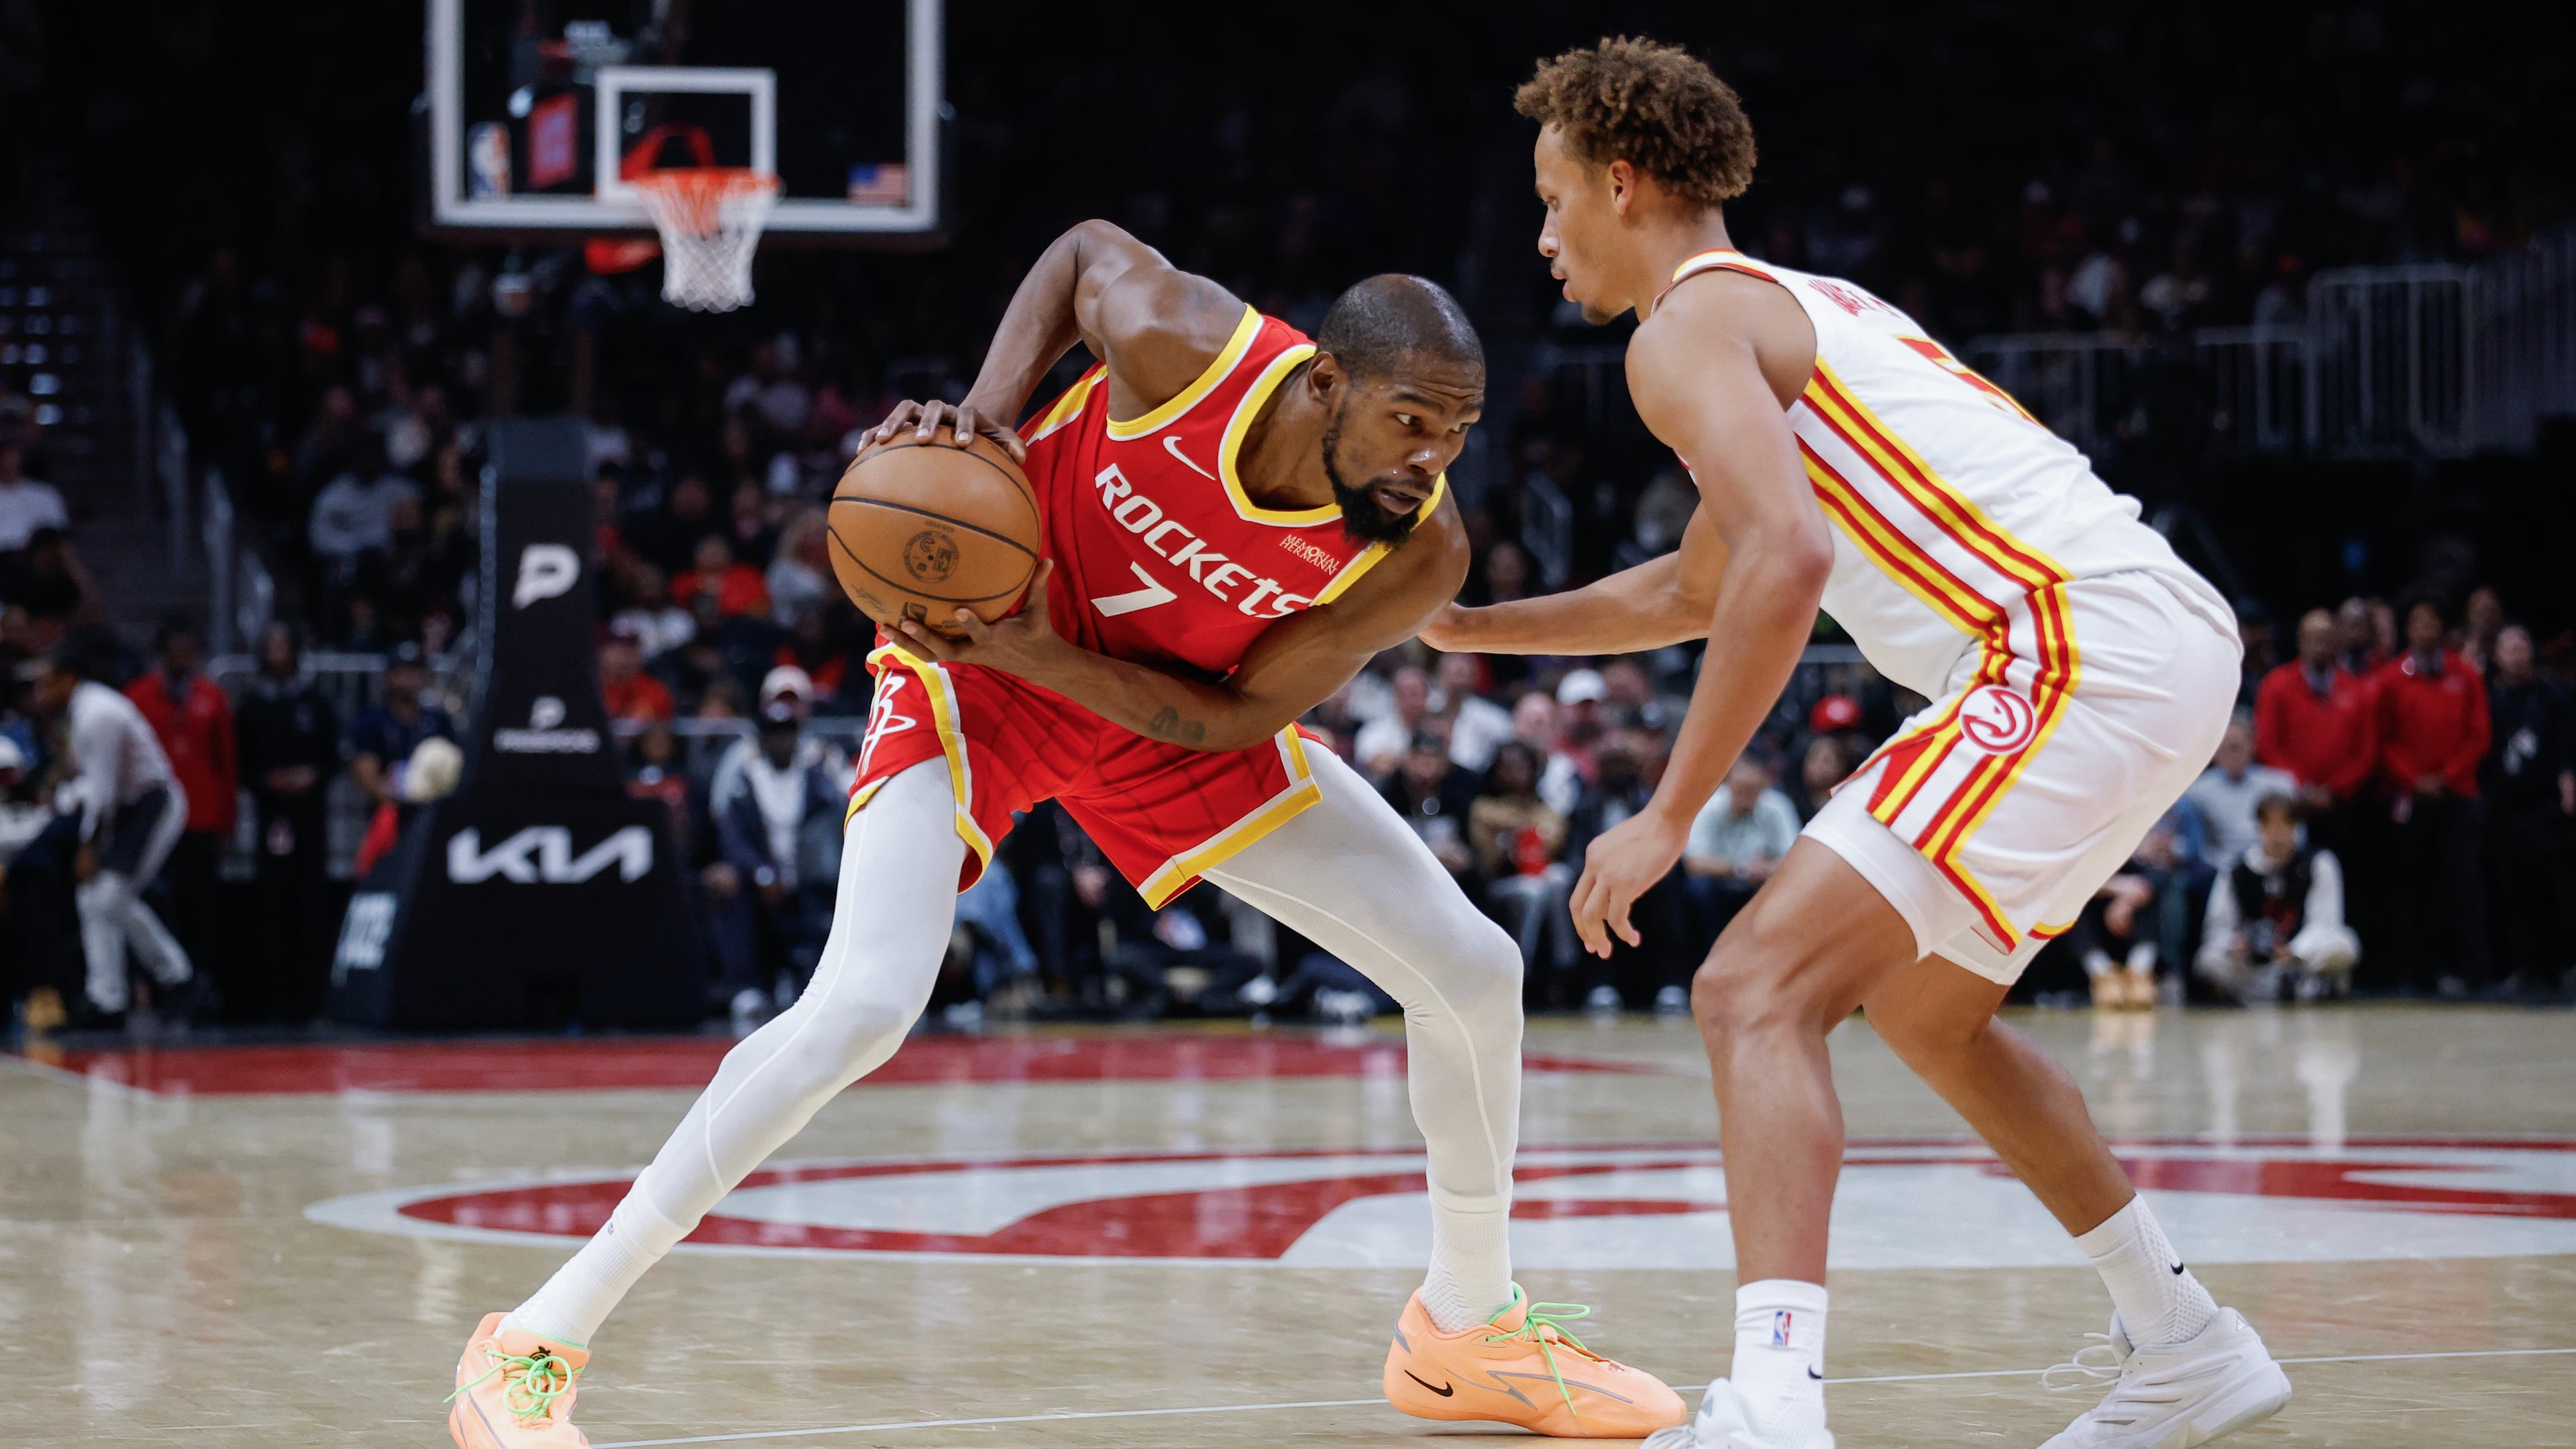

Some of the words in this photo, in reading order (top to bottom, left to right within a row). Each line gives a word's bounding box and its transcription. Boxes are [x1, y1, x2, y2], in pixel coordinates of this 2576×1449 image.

[1279, 540, 1336, 576] HERMANN
[1281, 534, 1340, 571] MEMORIAL
[1091, 561, 1177, 617] 7
[447, 826, 653, 883] KIA
